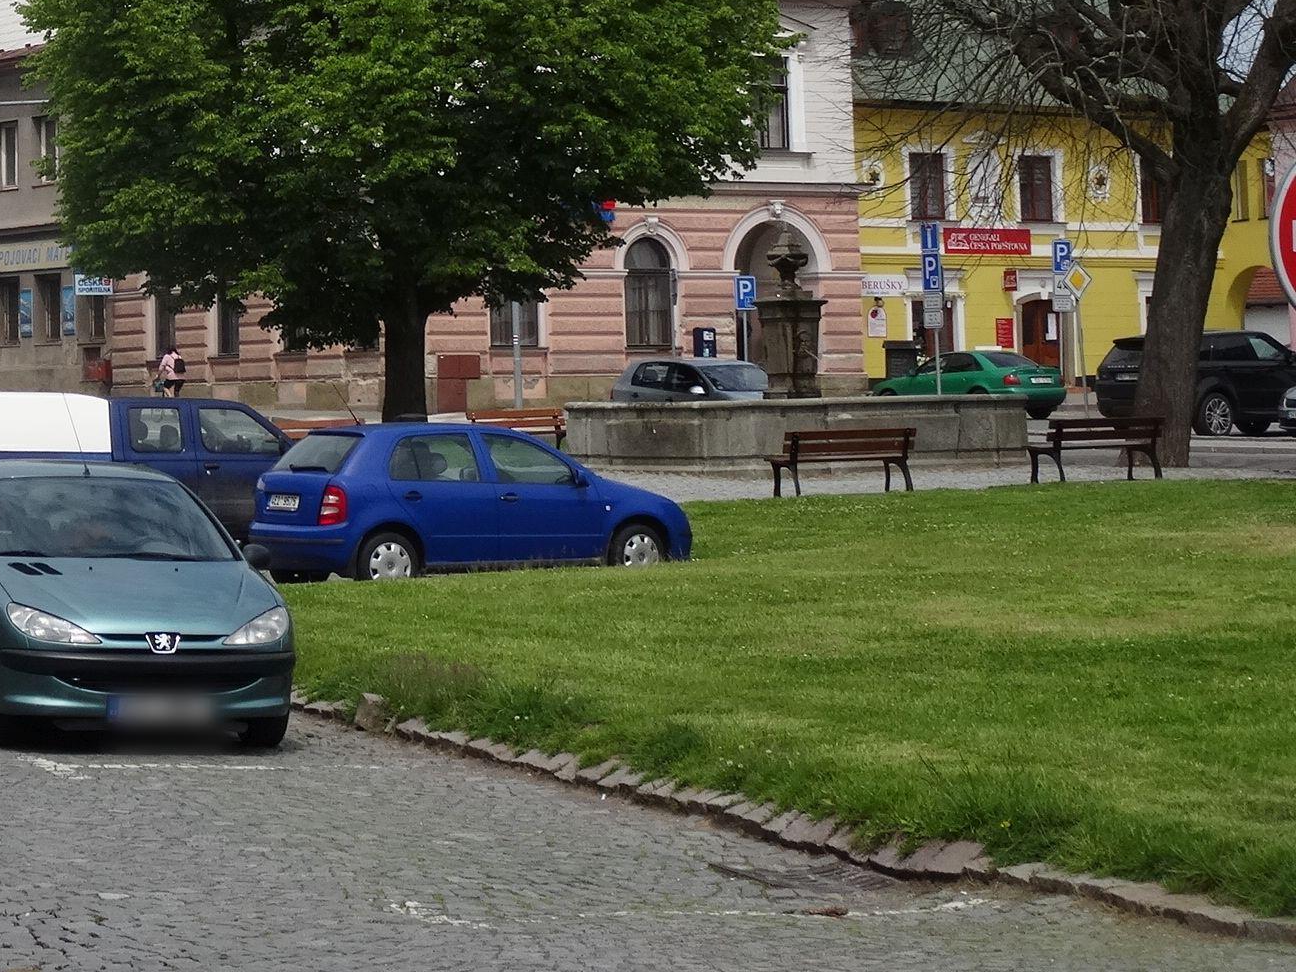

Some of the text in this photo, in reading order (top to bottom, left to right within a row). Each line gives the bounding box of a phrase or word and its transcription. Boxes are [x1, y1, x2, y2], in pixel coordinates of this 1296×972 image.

[47, 246, 70, 262] MATE
[1057, 244, 1068, 263] P
[925, 256, 936, 280] P
[739, 280, 752, 300] P
[861, 278, 904, 290] BERUŠKY
